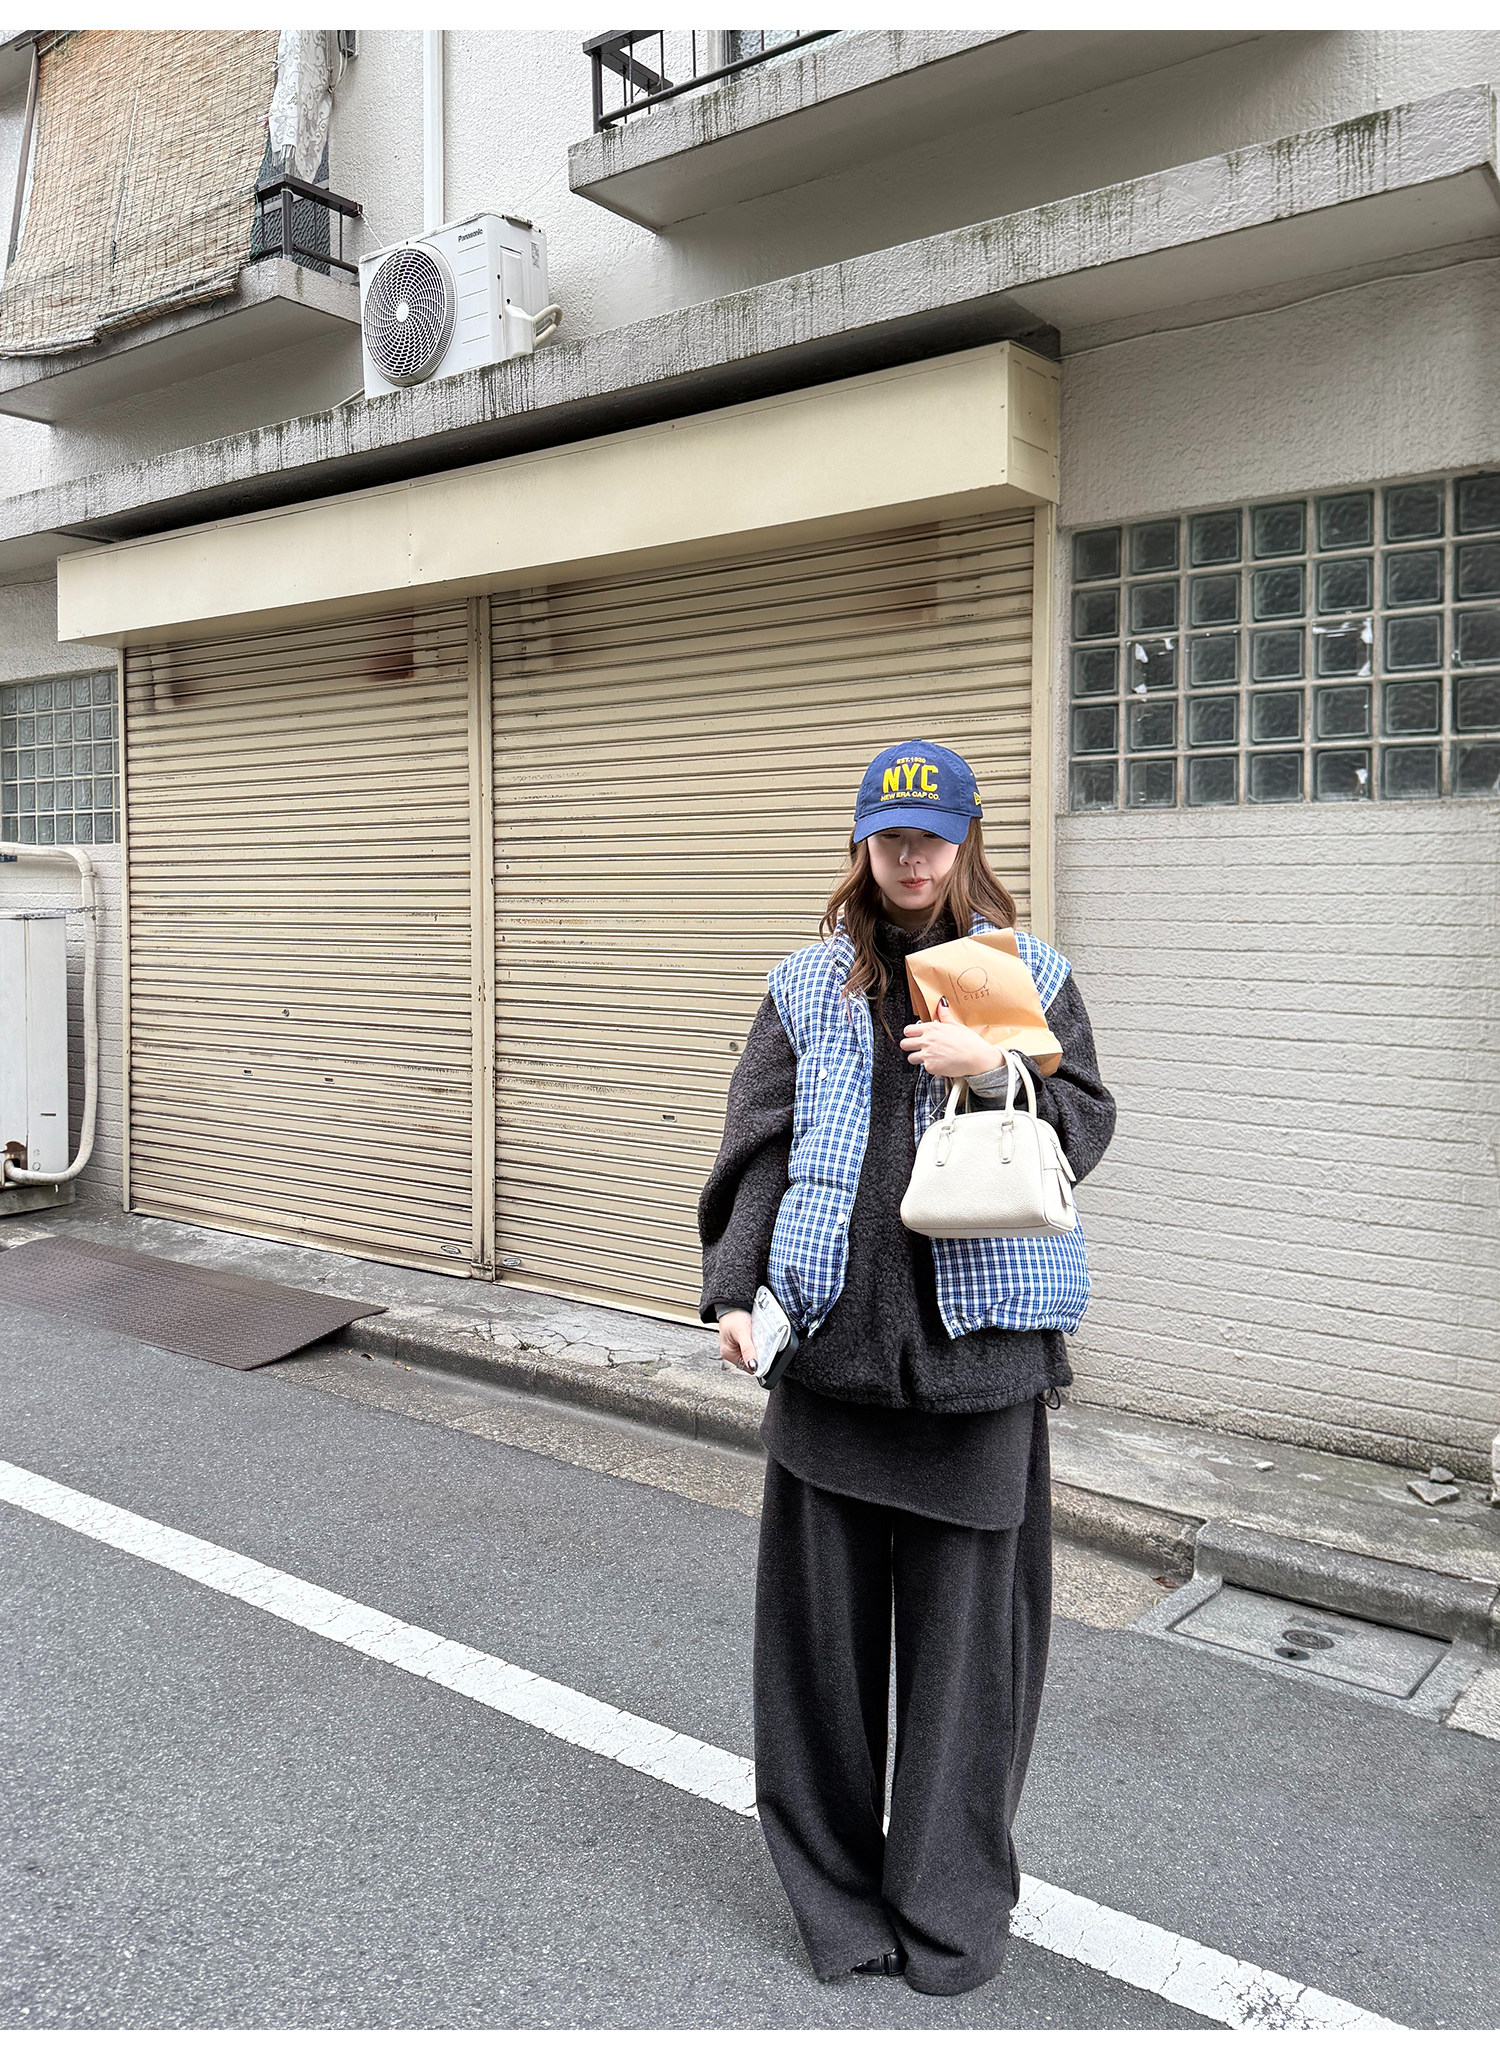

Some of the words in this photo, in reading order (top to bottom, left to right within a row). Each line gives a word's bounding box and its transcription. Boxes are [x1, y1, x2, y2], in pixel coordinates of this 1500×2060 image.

[458, 228, 483, 242] Panasonic
[882, 763, 939, 793] NYC
[880, 793, 895, 801] NEW
[928, 792, 940, 801] CO.
